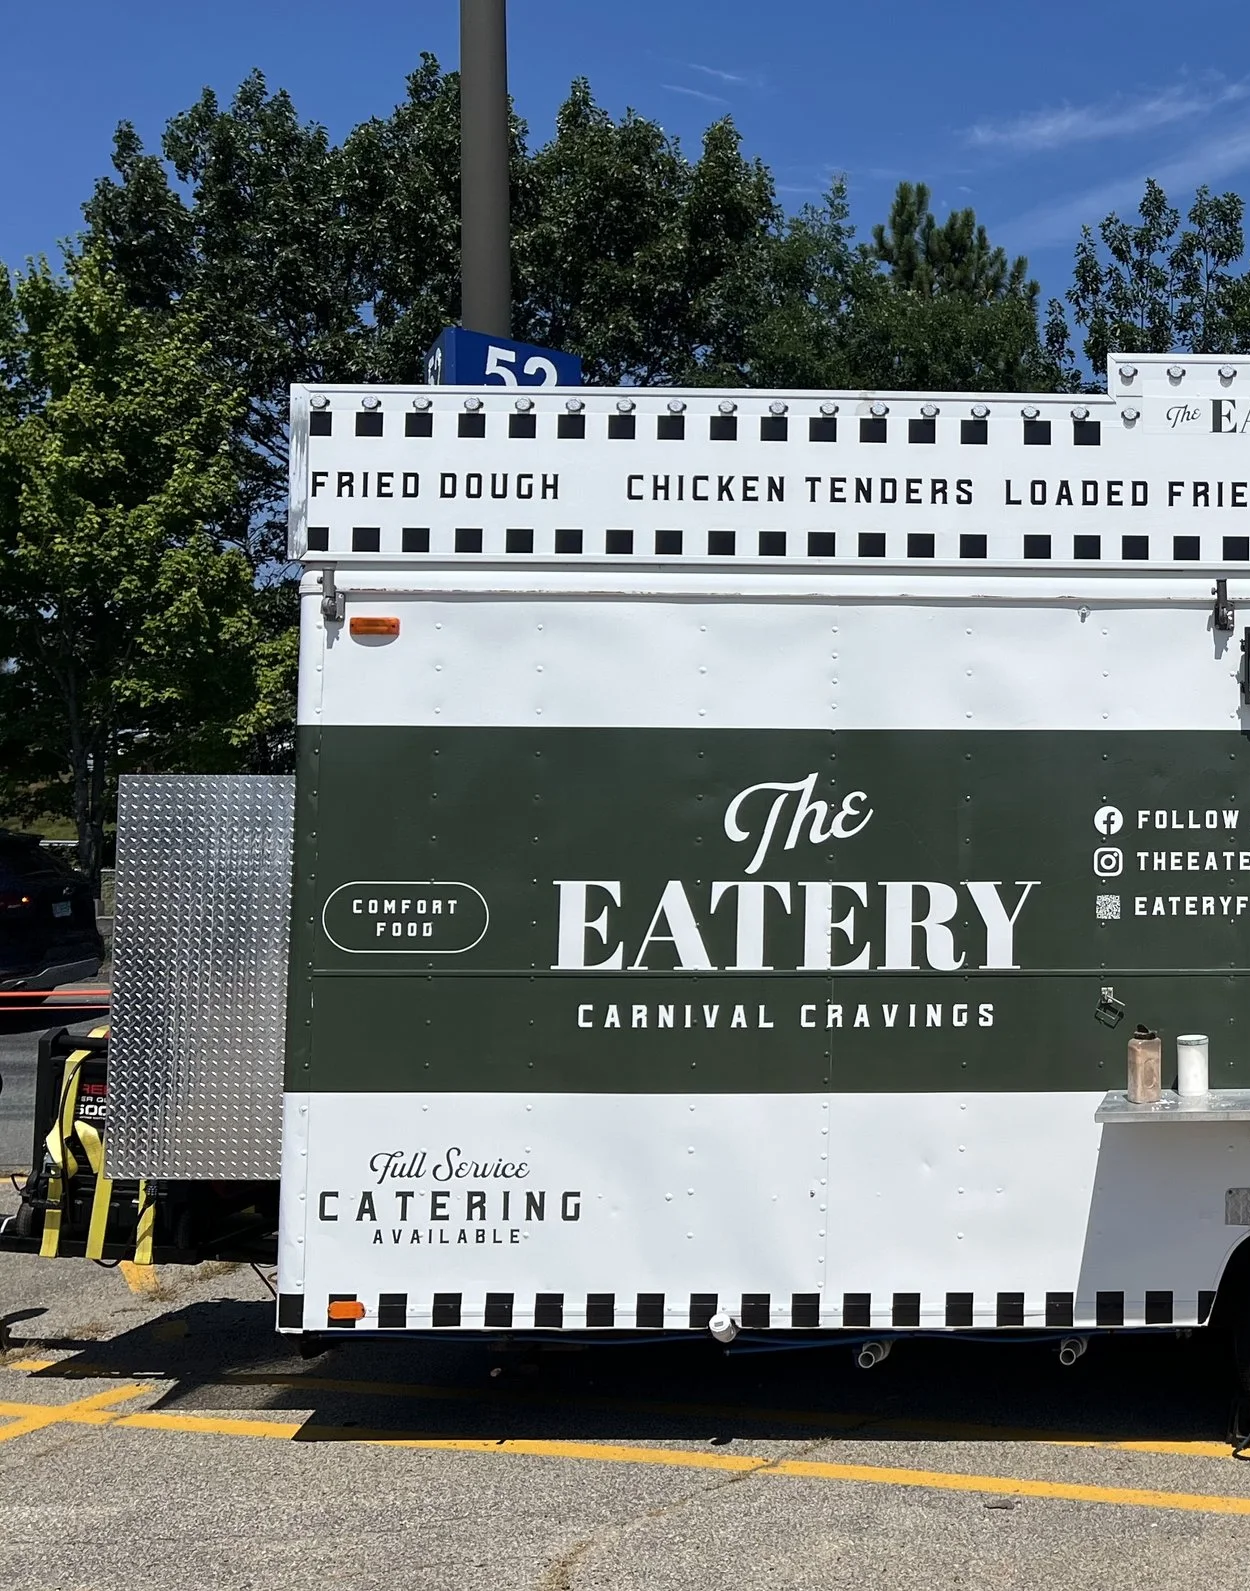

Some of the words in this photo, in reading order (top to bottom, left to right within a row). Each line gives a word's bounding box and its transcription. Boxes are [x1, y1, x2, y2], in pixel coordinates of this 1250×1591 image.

[486, 346, 557, 386] 52
[1167, 405, 1200, 428] The
[312, 472, 419, 497] FRIED
[440, 473, 558, 499] DOUGH
[628, 475, 784, 501] CHICKEN
[805, 477, 972, 504] TENDERS
[1006, 480, 1147, 506] LOADED
[725, 773, 873, 874] The
[1138, 810, 1239, 828] FOLLOW
[353, 900, 457, 914] COMFORT
[377, 923, 432, 936] FOOD
[551, 881, 1041, 971] EATERY
[578, 1005, 773, 1027] CARNIVAL
[801, 1004, 993, 1028] CRAVINGS
[370, 1151, 426, 1184] Full
[433, 1147, 529, 1181] Service
[319, 1191, 580, 1221] CATERING
[373, 1229, 519, 1244] AVAILABLE
